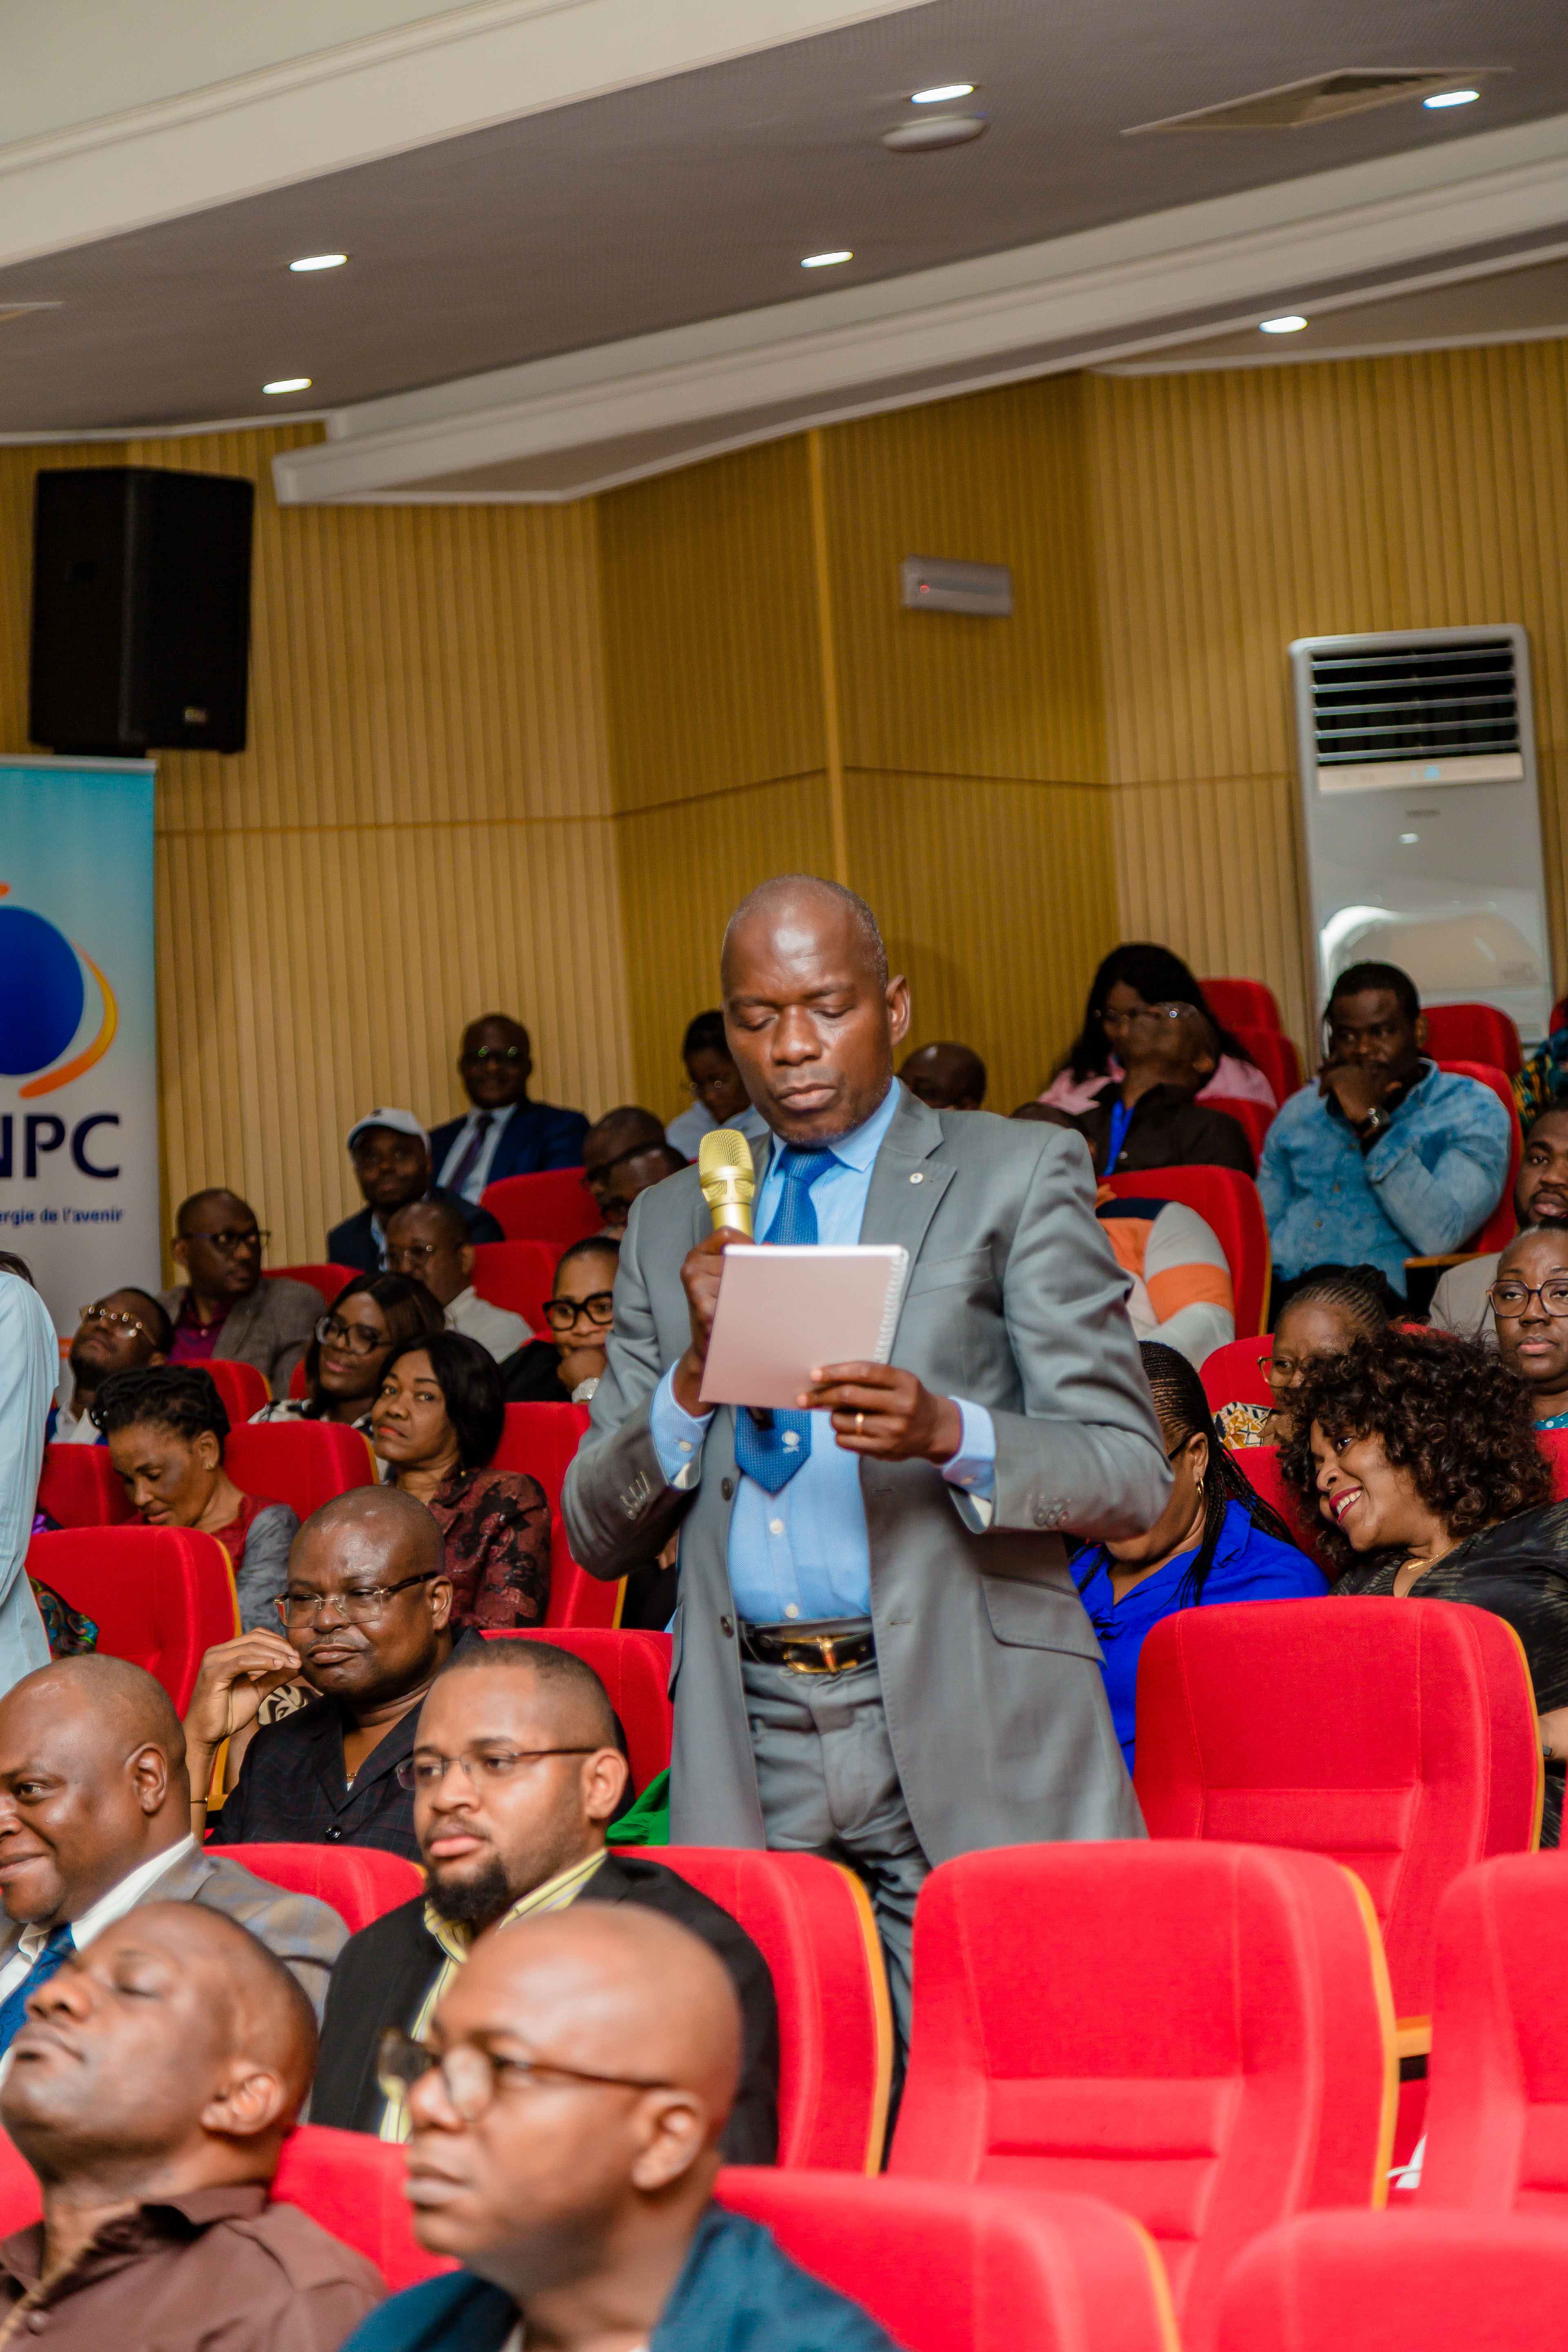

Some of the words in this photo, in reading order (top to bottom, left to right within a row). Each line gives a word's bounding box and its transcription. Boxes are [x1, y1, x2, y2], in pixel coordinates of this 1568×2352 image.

[0, 1114, 120, 1178] PC
[0, 1207, 34, 1227] rgie
[40, 1207, 57, 1223] de
[62, 1207, 122, 1223] l'avenir
